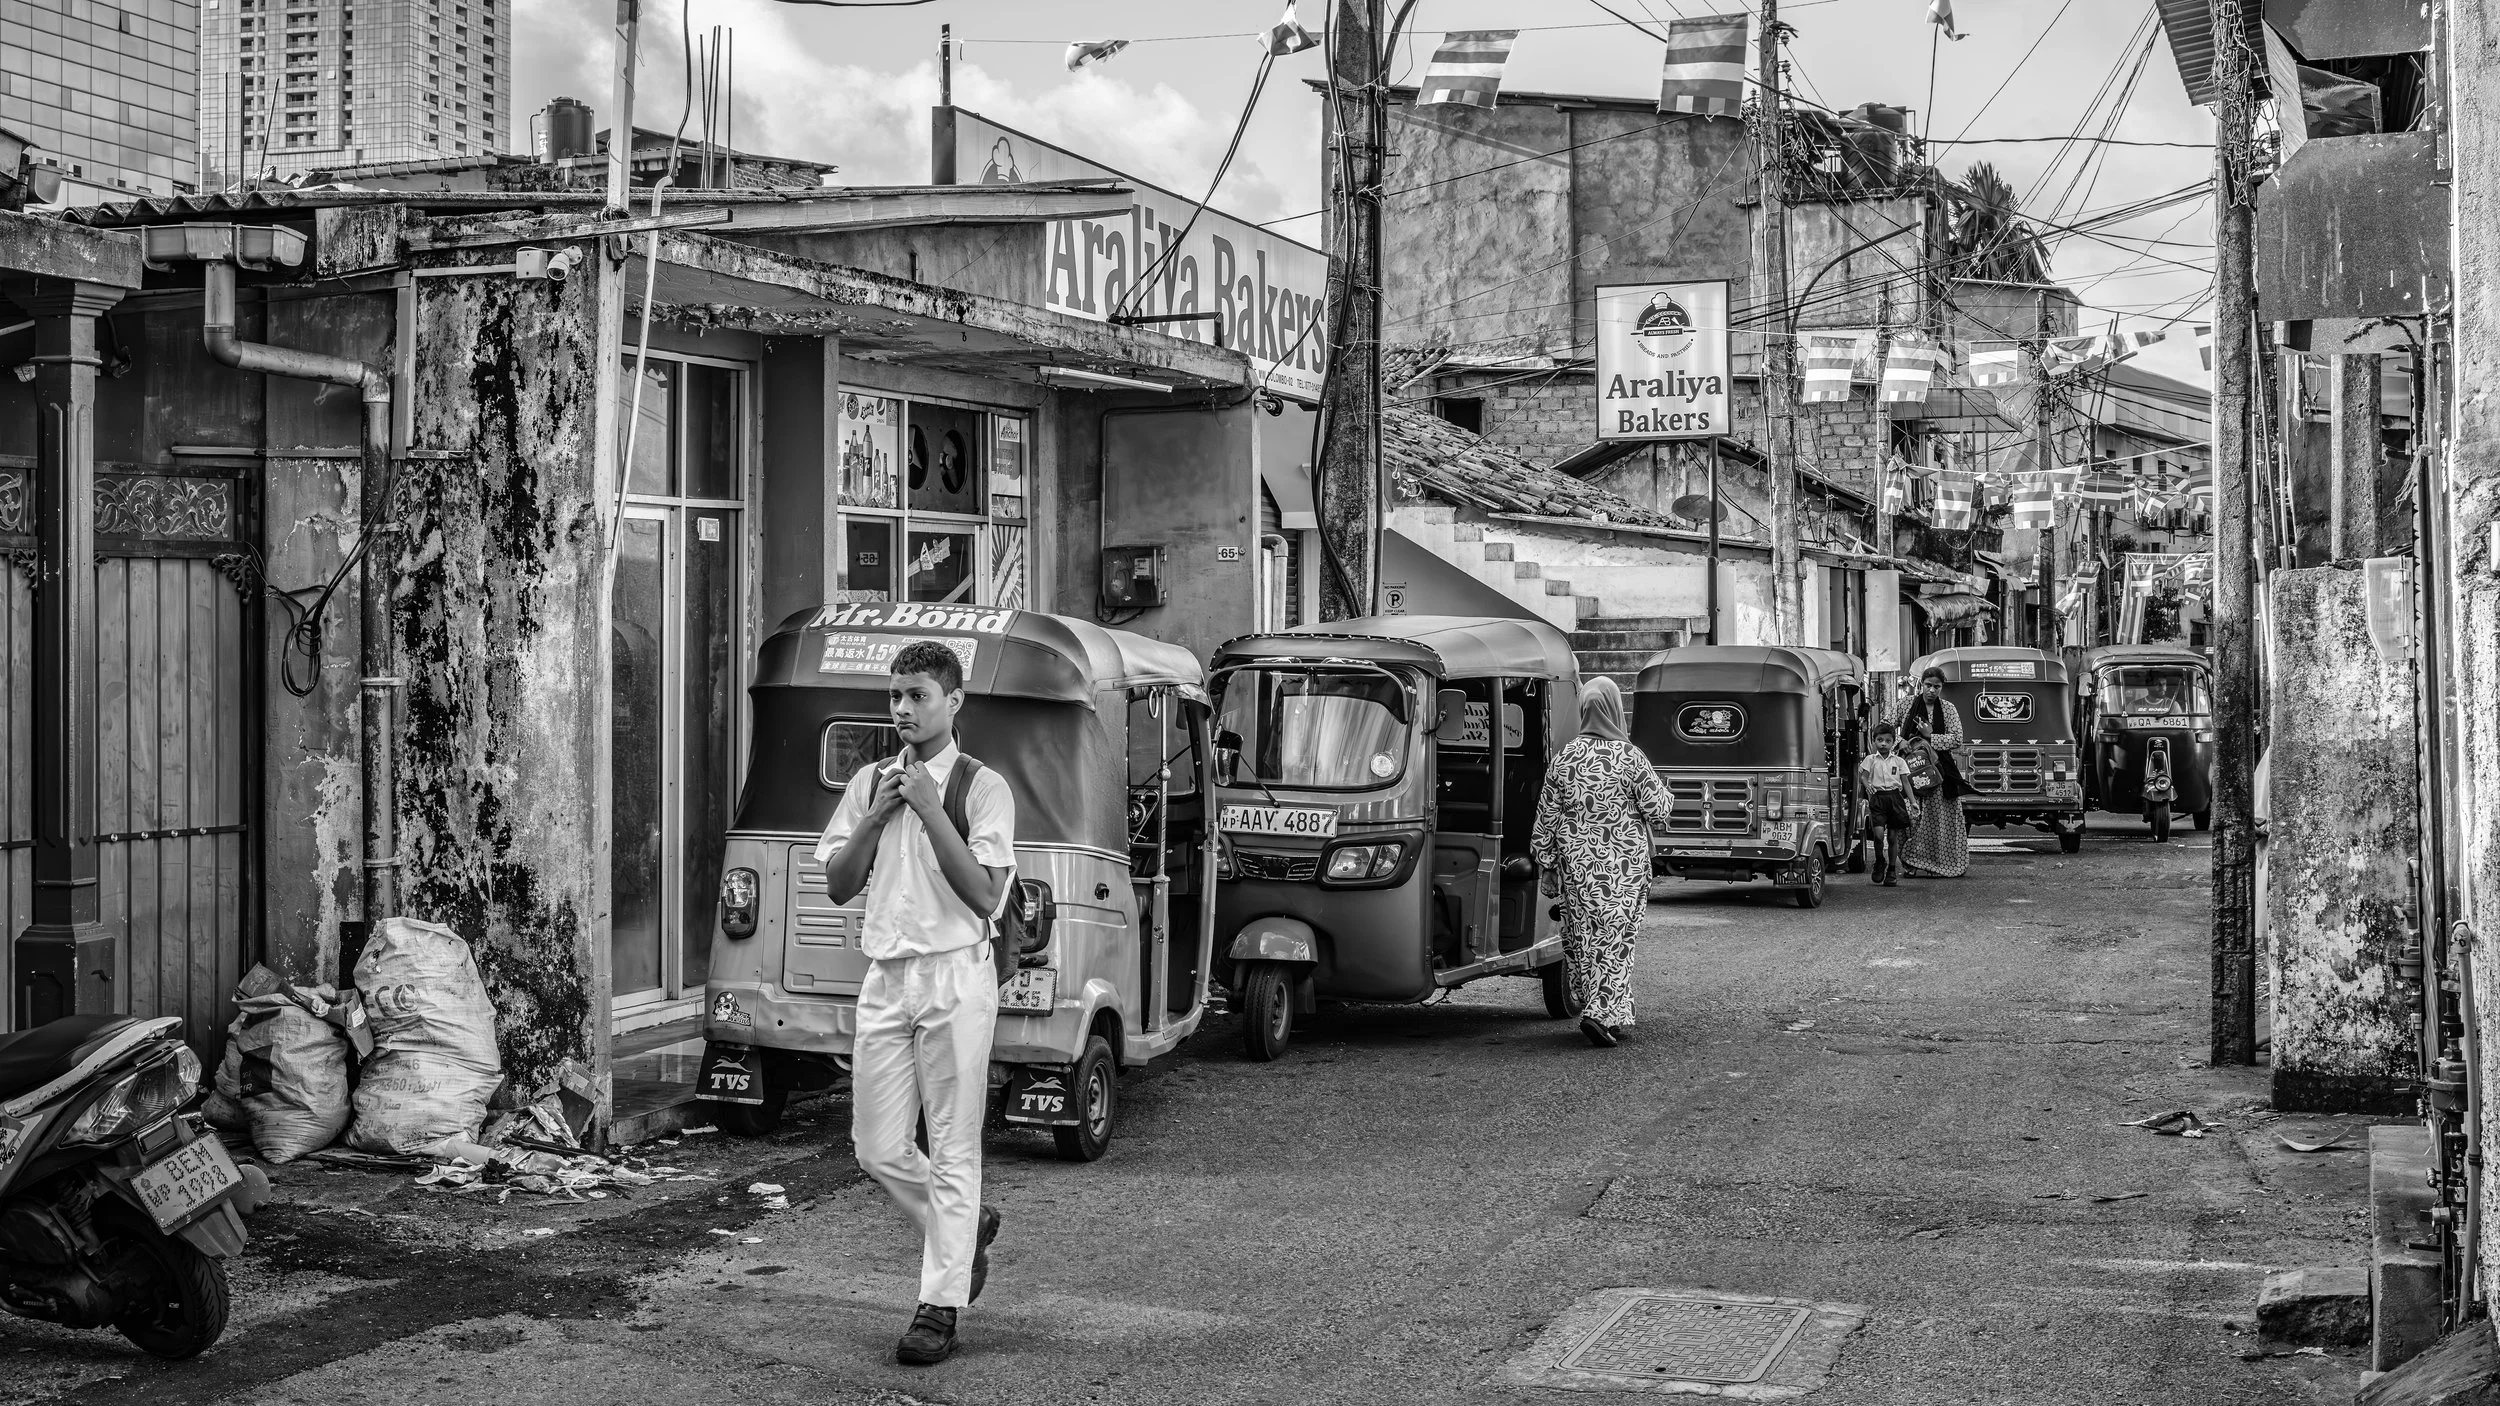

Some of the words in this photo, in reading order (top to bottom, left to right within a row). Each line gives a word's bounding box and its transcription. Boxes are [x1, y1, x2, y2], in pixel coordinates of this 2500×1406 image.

[1046, 204, 1200, 340] Araliya
[1212, 234, 1327, 374] Bakers
[1638, 342, 1656, 357] BREADS
[1670, 341, 1693, 358] PASTRIES
[1605, 370, 1723, 403] Araliya
[1618, 408, 1710, 433] Bakers
[1221, 548, 1235, 559] 65
[810, 603, 1013, 633] Mr.Bond
[825, 647, 865, 659] 最高返水
[2138, 718, 2151, 727] QA
[2163, 718, 2187, 727] 6861
[1240, 809, 1275, 830] AAY
[1284, 811, 1335, 834] 4887
[1773, 822, 1792, 832] ABM
[1771, 831, 1793, 841] 9037
[710, 1073, 751, 1091] TVS
[1021, 1093, 1065, 1112] TVS
[164, 1142, 214, 1182] BEM
[178, 1165, 229, 1208] 1998
